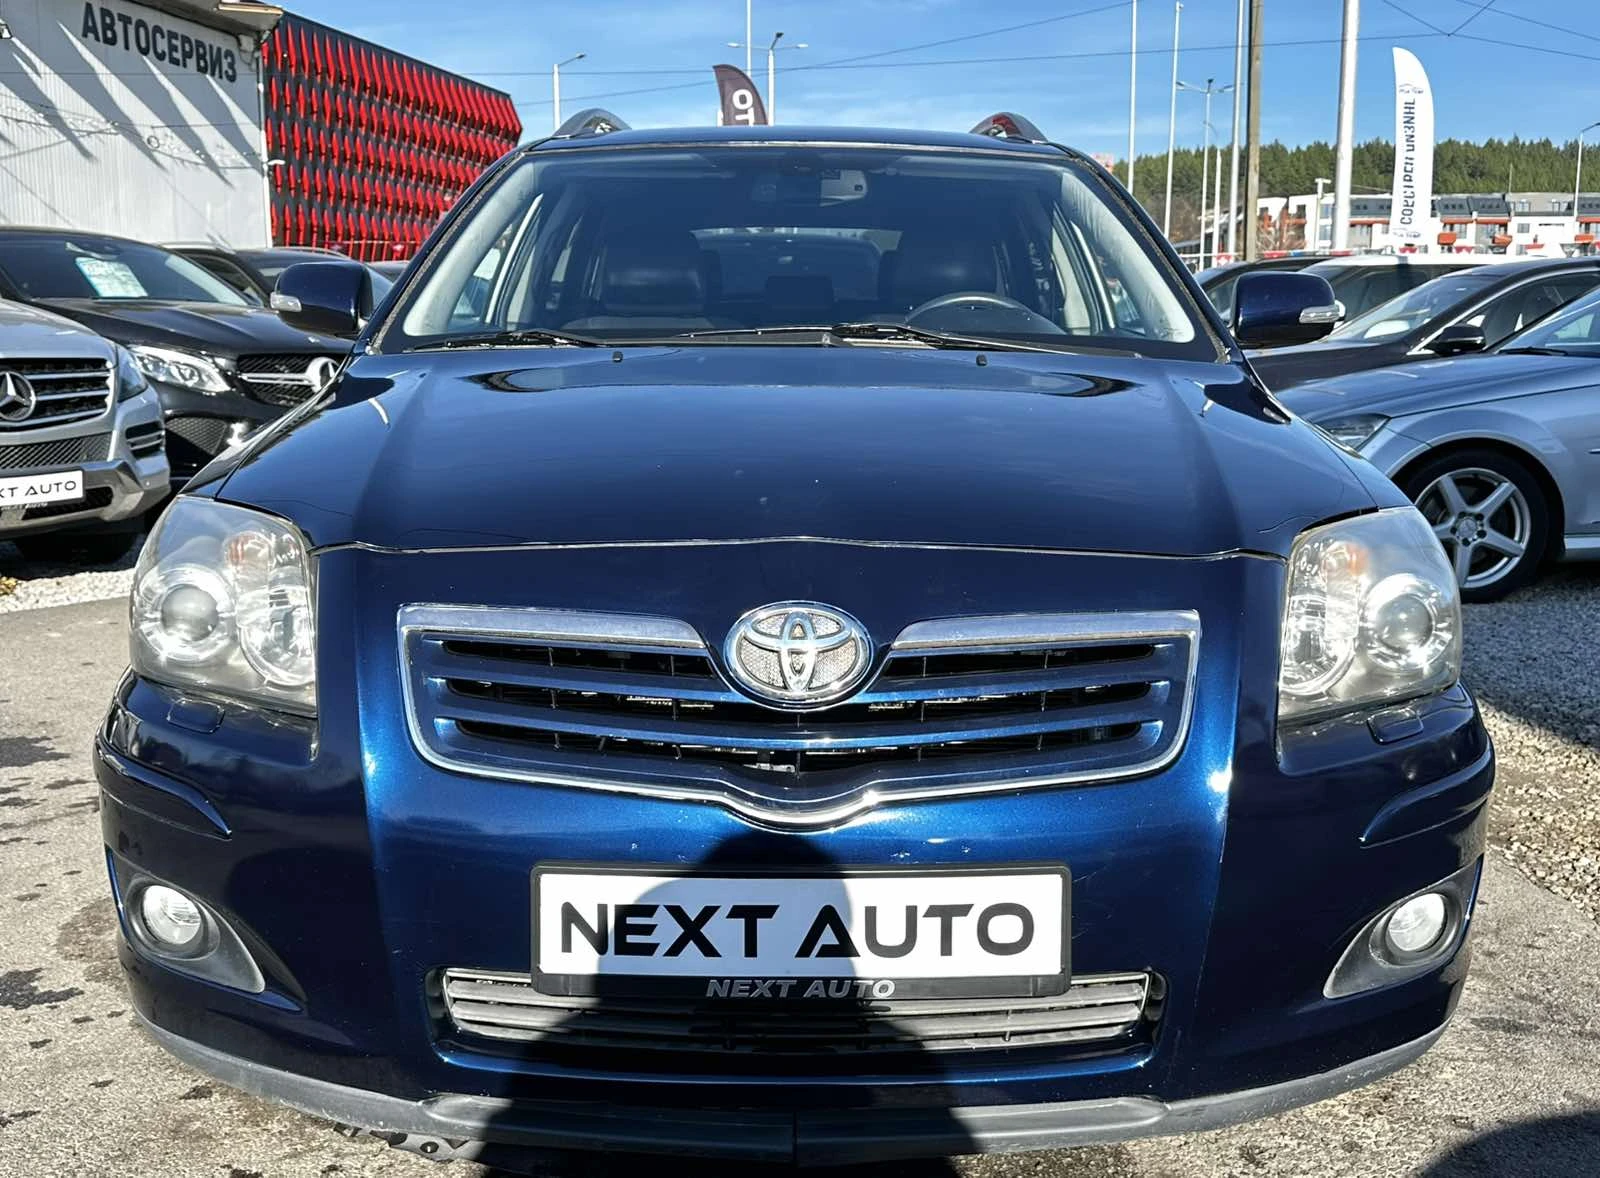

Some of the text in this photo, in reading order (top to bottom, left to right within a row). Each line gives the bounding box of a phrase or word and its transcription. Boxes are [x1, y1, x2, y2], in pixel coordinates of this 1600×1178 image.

[82, 2, 237, 83] АВТОСЕРВИЗ
[25, 481, 77, 496] AUTO
[561, 901, 1035, 957] NEXT AUTO
[706, 979, 896, 999] NEXT AUTO
